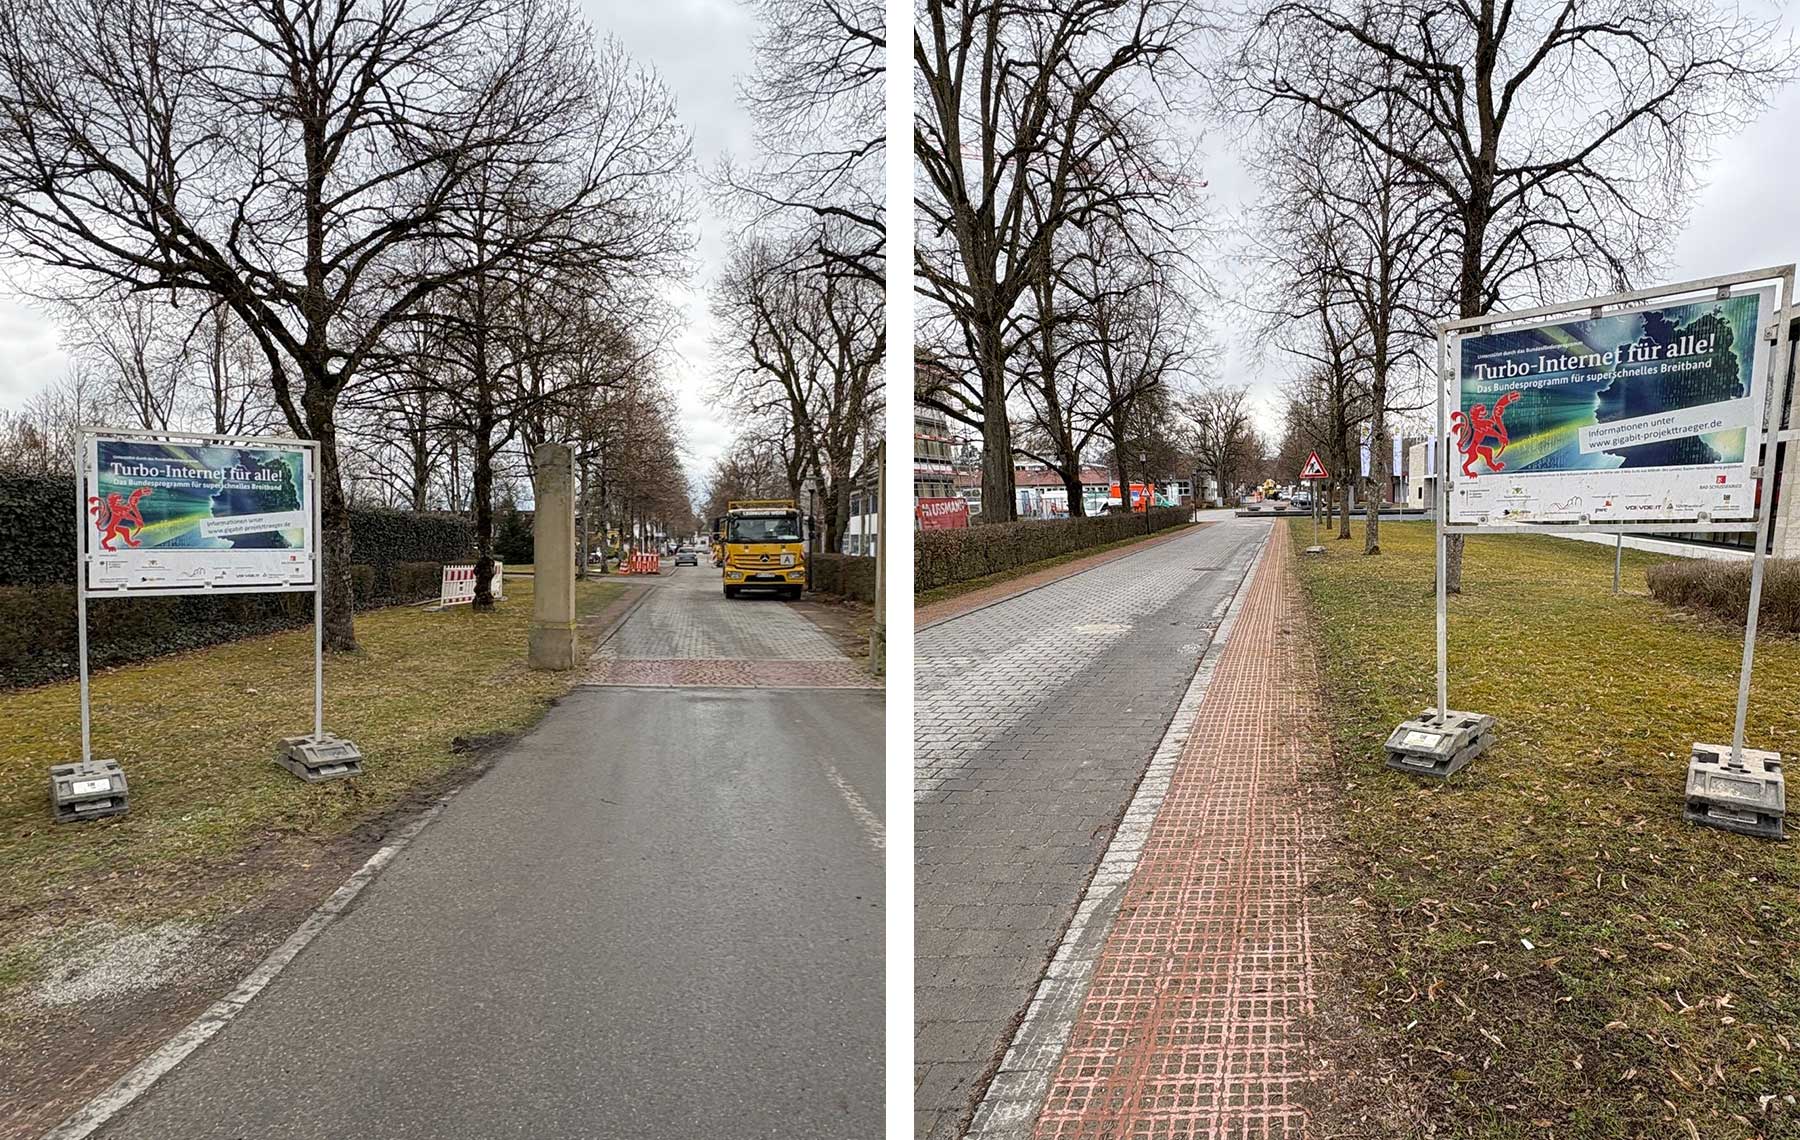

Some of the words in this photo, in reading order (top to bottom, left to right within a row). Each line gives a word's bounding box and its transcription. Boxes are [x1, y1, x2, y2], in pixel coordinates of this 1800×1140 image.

[1474, 346, 1622, 380] Turbo-Internet
[1627, 342, 1661, 363] für
[1666, 333, 1715, 358] alle!
[1477, 384, 1492, 393] Das
[1493, 376, 1568, 391] Bundesprogramm
[1570, 373, 1584, 383] für
[1587, 364, 1658, 383] superschnelles
[1660, 358, 1712, 373] Breitband
[1588, 420, 1649, 438] Informationen
[1651, 416, 1675, 428] unter
[1588, 419, 1722, 449] www.gigabit-projekttraeger.de
[110, 462, 227, 480] Turbo-Internet
[230, 467, 251, 481] für
[254, 469, 282, 482] alle!
[128, 479, 190, 489] Bundesprogramm
[251, 483, 282, 491] Breitband
[783, 555, 791, 564] A
